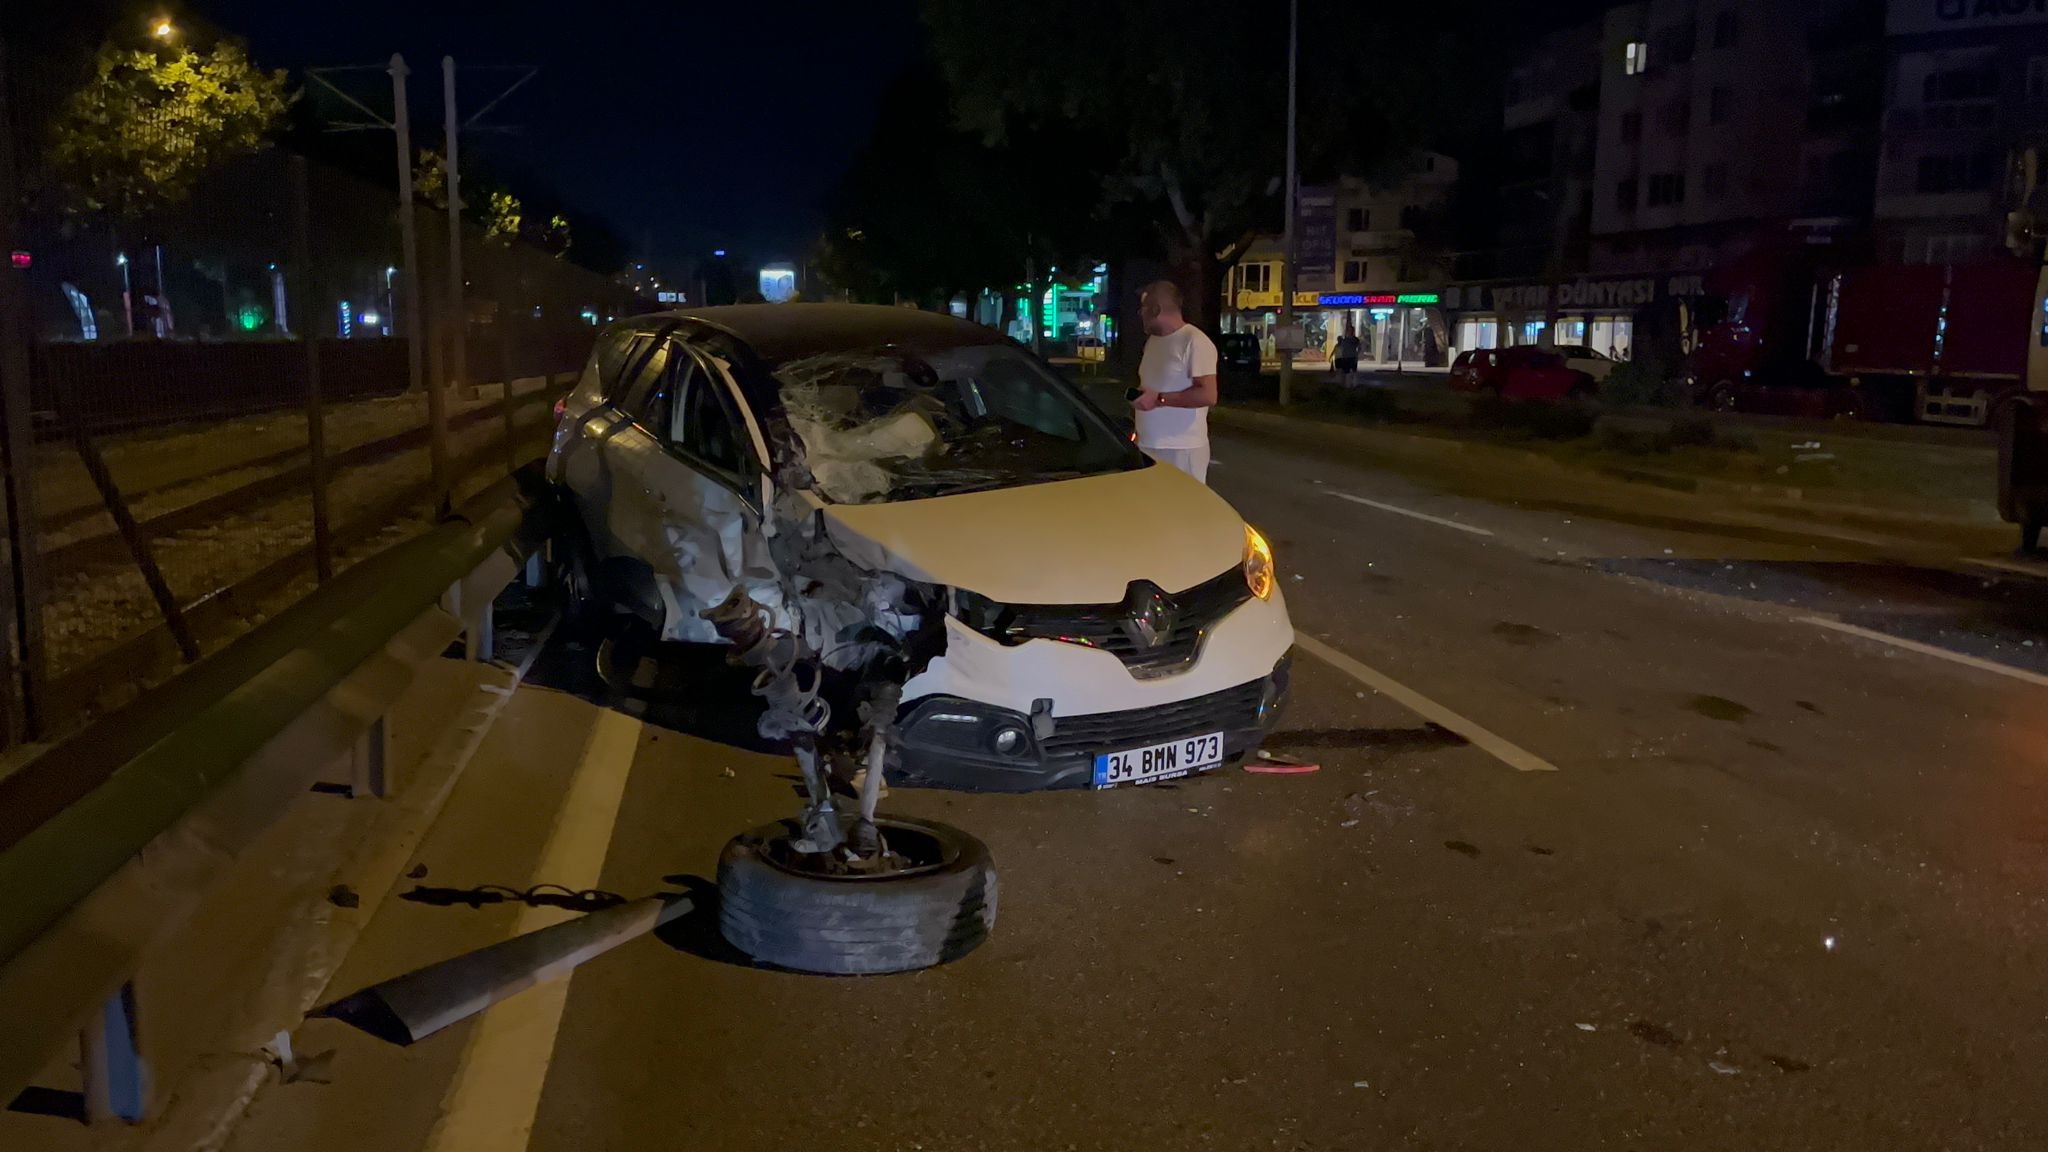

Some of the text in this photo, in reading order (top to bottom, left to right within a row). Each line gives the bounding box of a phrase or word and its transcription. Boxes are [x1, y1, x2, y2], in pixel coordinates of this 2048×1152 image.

[1109, 736, 1219, 780] 34 BMN 973
[1158, 770, 1188, 781] BURSA
